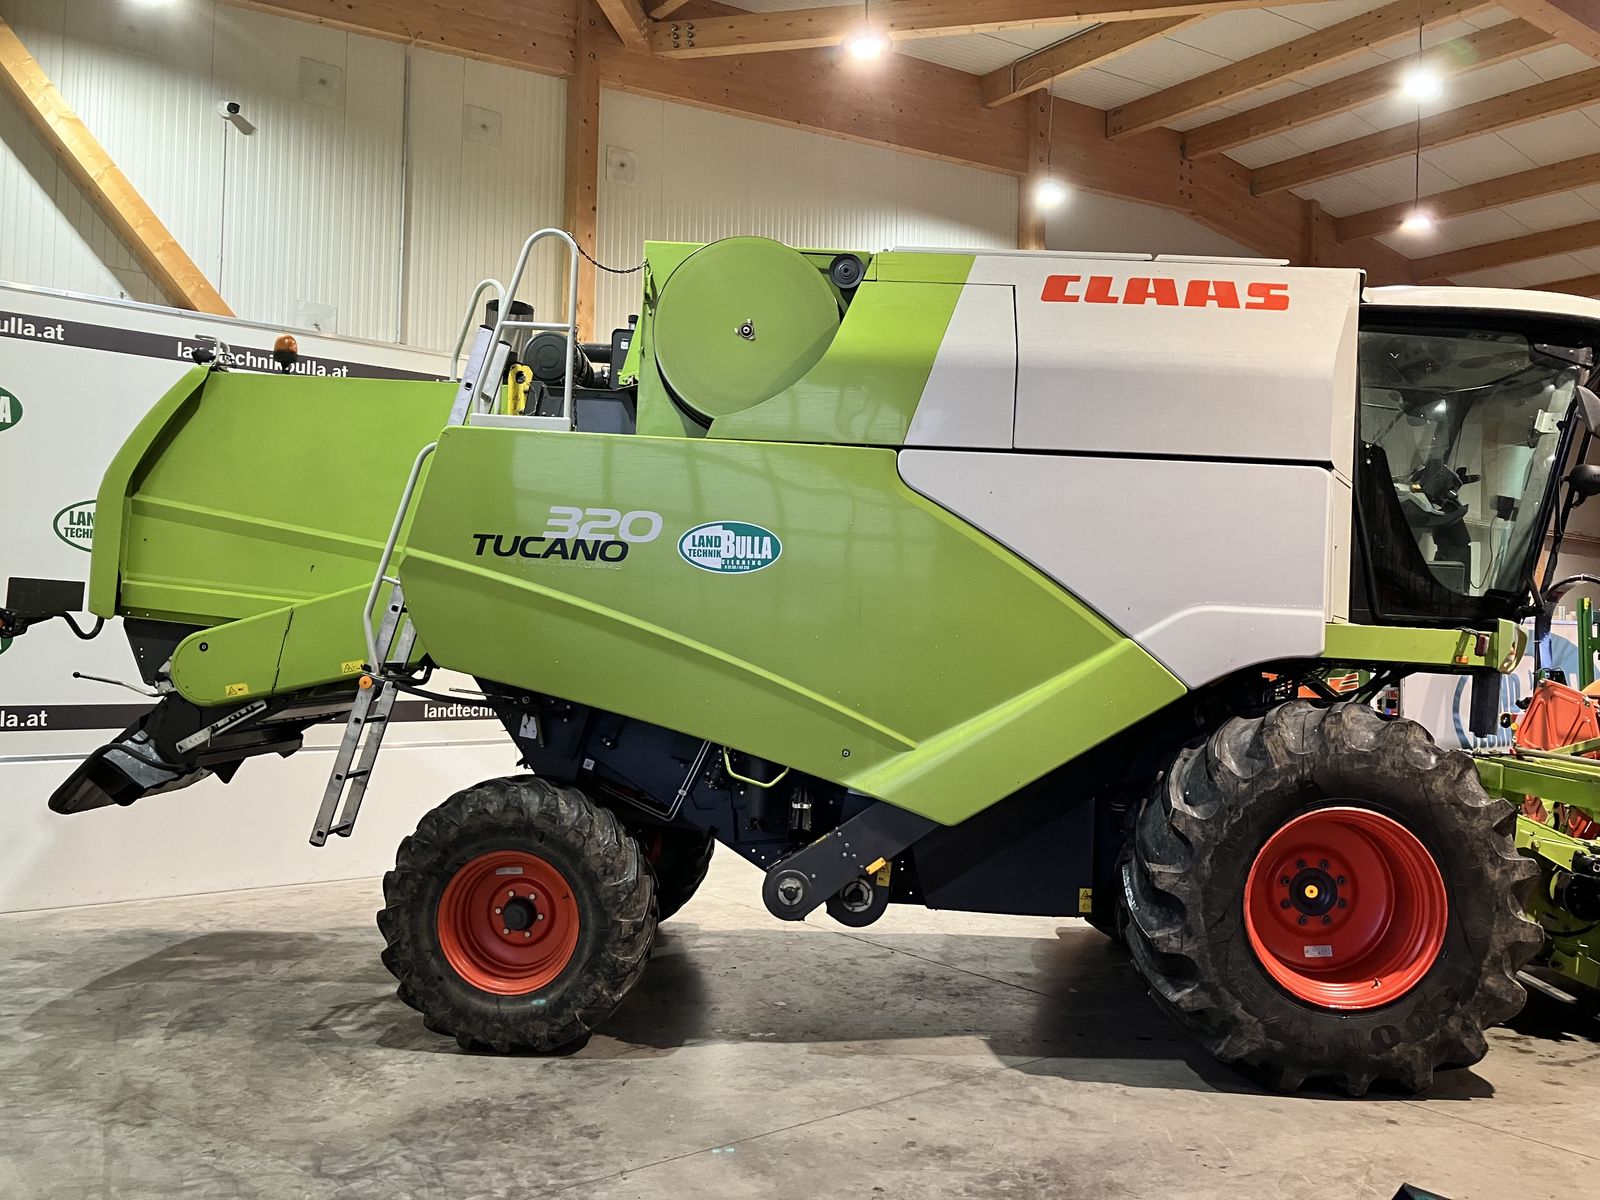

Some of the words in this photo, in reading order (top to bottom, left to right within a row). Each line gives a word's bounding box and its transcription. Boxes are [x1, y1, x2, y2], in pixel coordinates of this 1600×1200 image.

[1041, 275, 1290, 310] CLAAS
[543, 506, 663, 543] 320
[473, 534, 629, 562] TUCANO
[688, 548, 721, 558] TECHNIK
[692, 534, 721, 548] LAND
[721, 529, 772, 559] BULLA
